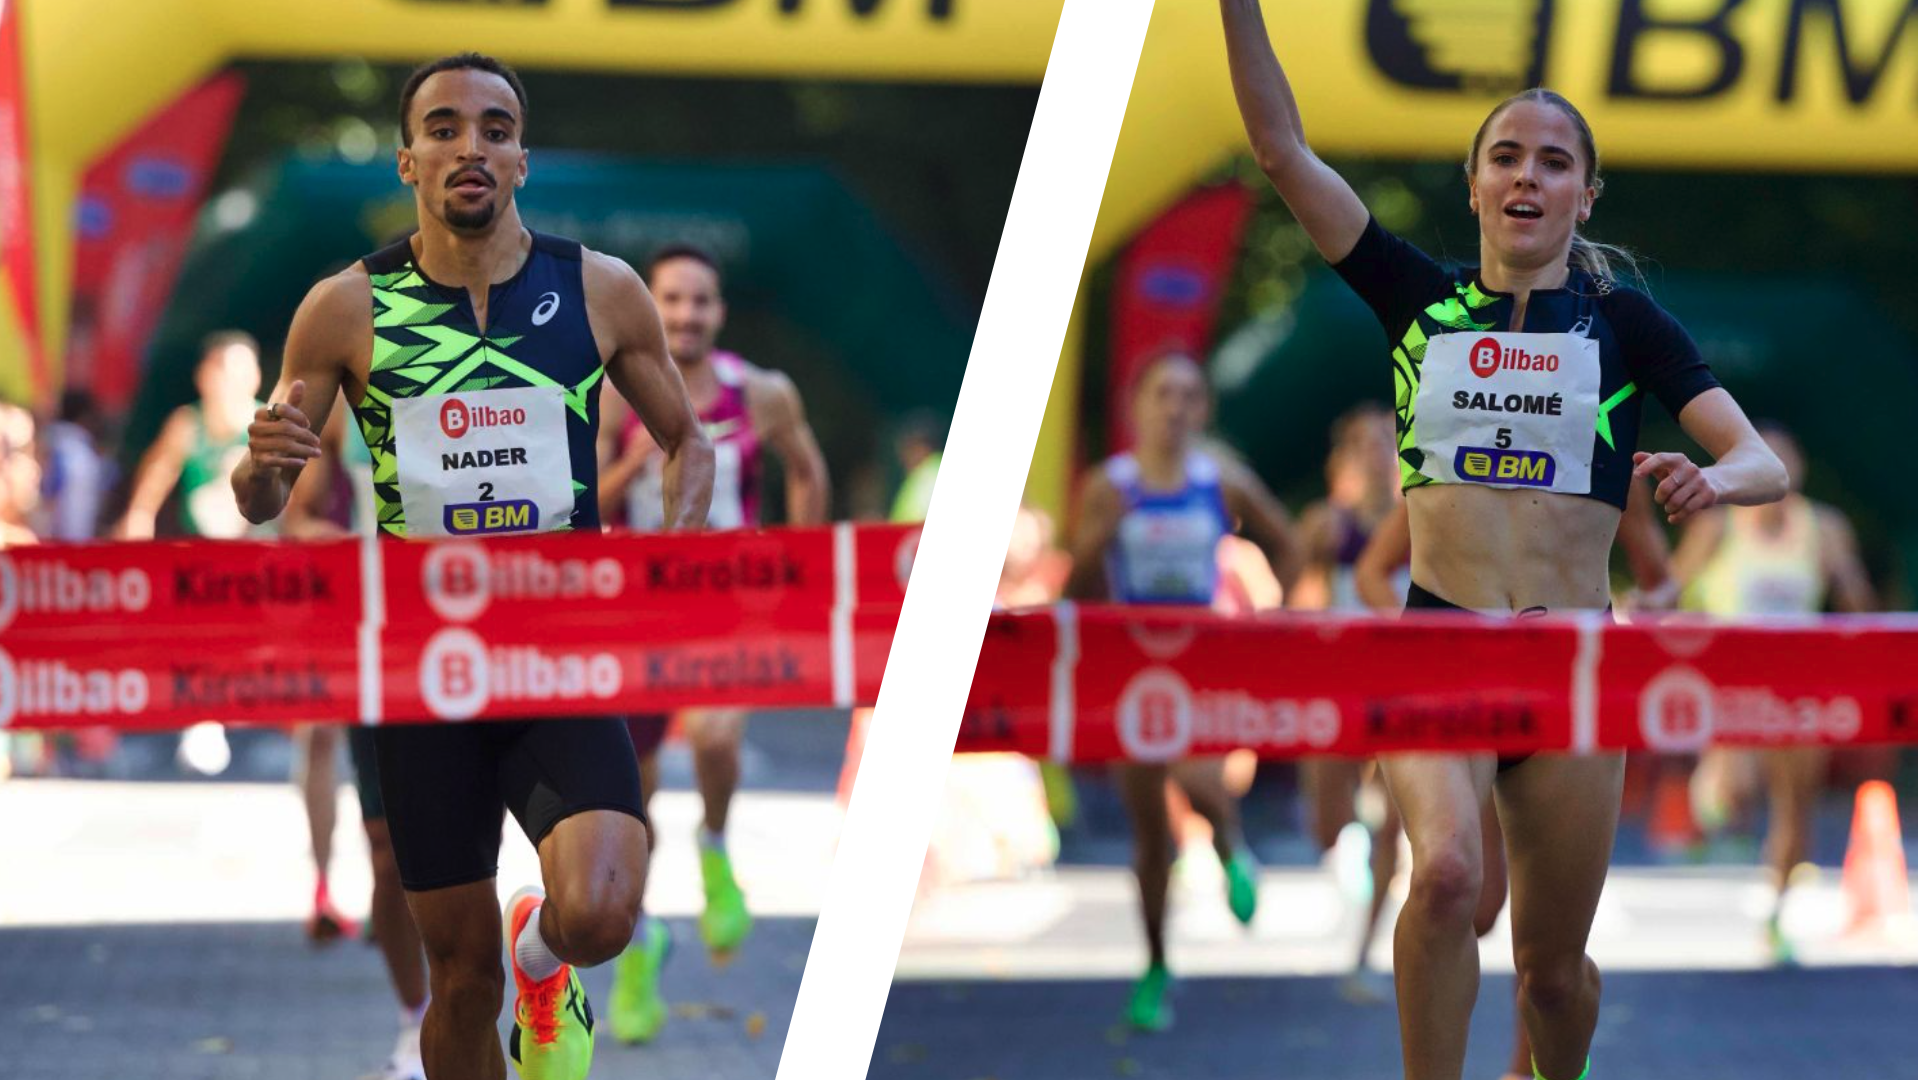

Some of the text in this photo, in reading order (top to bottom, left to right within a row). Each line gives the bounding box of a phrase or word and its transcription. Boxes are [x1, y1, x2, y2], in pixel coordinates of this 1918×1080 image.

[1471, 340, 1560, 375] Bilbao
[1452, 391, 1563, 416] SALOMÉ
[443, 402, 526, 435] Bilbao
[1494, 427, 1512, 449] 5
[441, 447, 528, 471] NADER
[1496, 455, 1548, 481] BM
[477, 482, 495, 502] 2
[484, 504, 530, 529] BM
[15, 559, 152, 613] ilbao
[429, 544, 625, 608] Bilbao
[15, 658, 150, 715] ilbao
[429, 636, 624, 708] Bilbao
